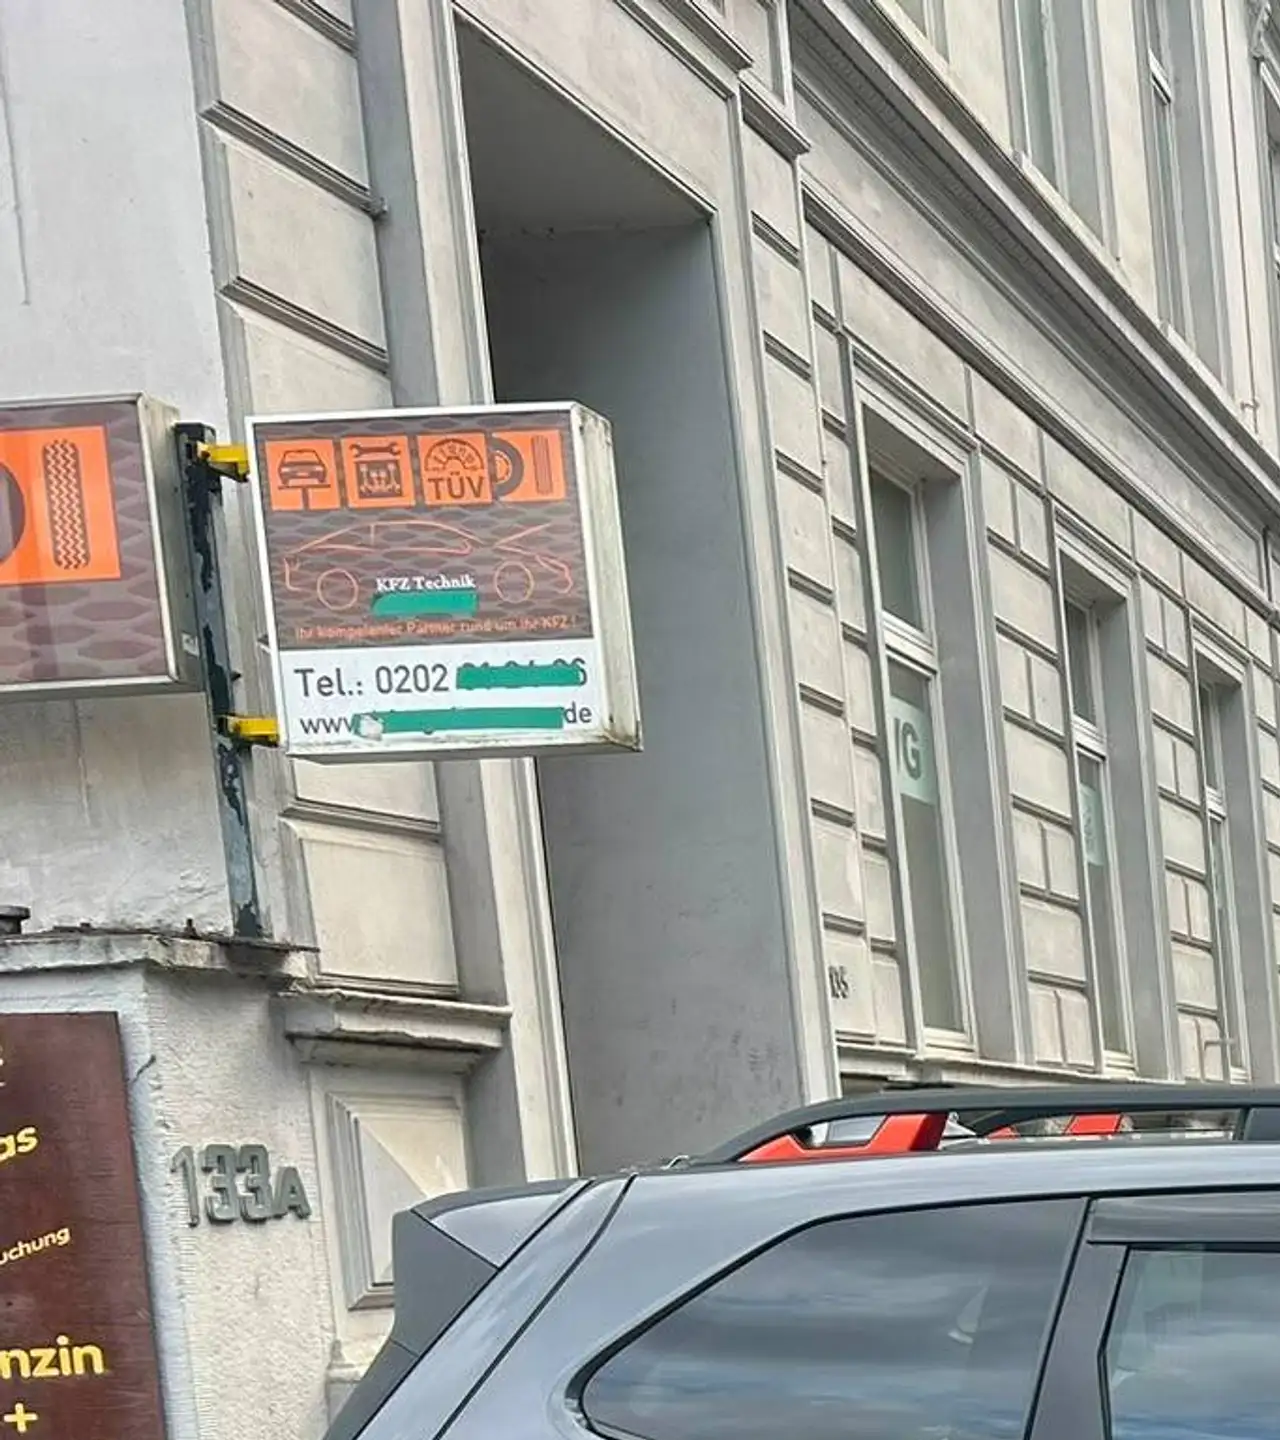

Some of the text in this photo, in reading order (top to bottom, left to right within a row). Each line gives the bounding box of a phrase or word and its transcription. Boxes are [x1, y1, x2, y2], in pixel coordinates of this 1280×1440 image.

[428, 470, 484, 499] TÜV
[376, 573, 476, 592] KFZ Technik
[294, 667, 363, 698] Tel.:
[375, 662, 449, 694] 0202
[170, 1144, 311, 1228] 133A
[0, 1335, 104, 1379] nzin
